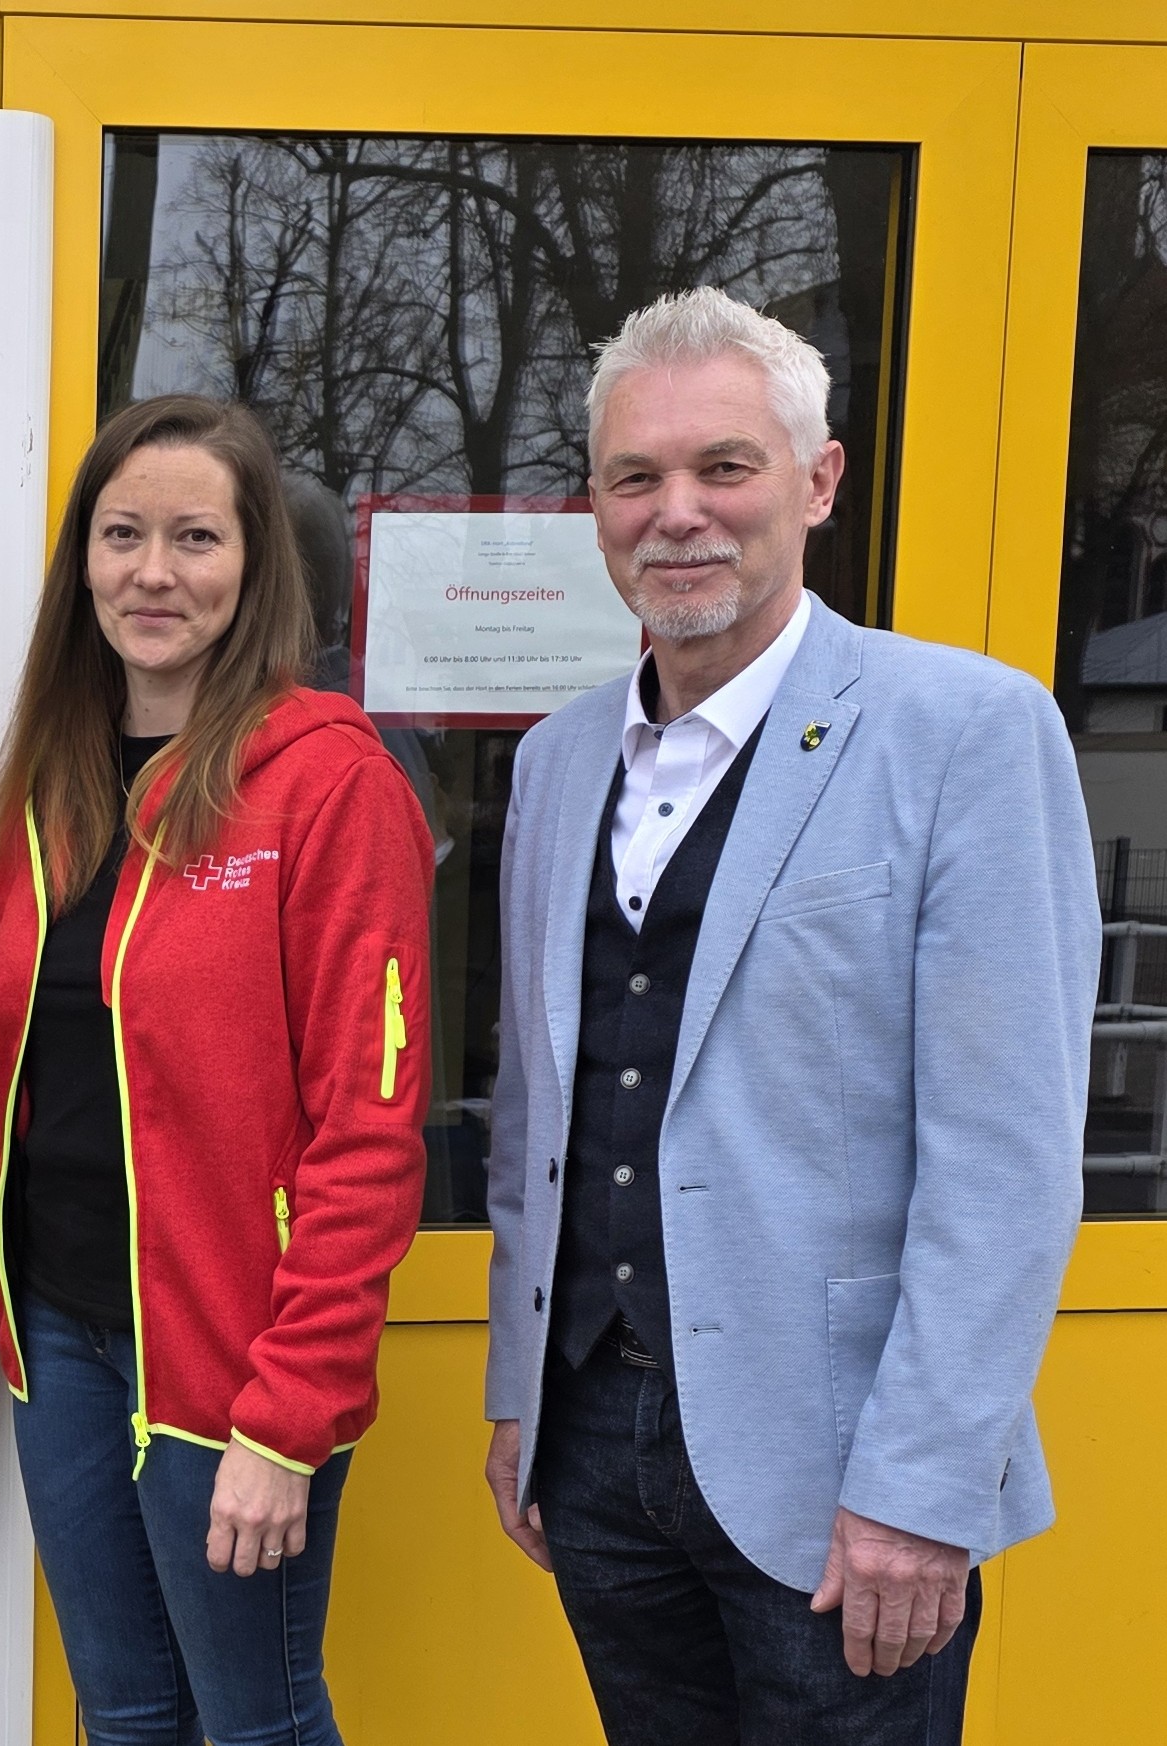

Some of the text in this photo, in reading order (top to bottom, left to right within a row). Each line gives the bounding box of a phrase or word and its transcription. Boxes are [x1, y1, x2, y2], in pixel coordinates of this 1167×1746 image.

[445, 584, 565, 605] Öffnungszeiten
[475, 625, 500, 633] Montag
[513, 625, 535, 633] Freitag
[439, 654, 452, 663] Uhr
[453, 654, 463, 663] bis
[480, 654, 492, 663] Uhr
[493, 654, 506, 663] und
[507, 654, 525, 663] 11:30
[526, 654, 538, 663] Uhr
[539, 654, 549, 663] bis
[551, 654, 569, 663] 17:30
[570, 654, 582, 663] Uhr
[226, 849, 280, 867] Deutsches
[224, 866, 251, 878] Rotes
[221, 878, 251, 890] Kreuz
